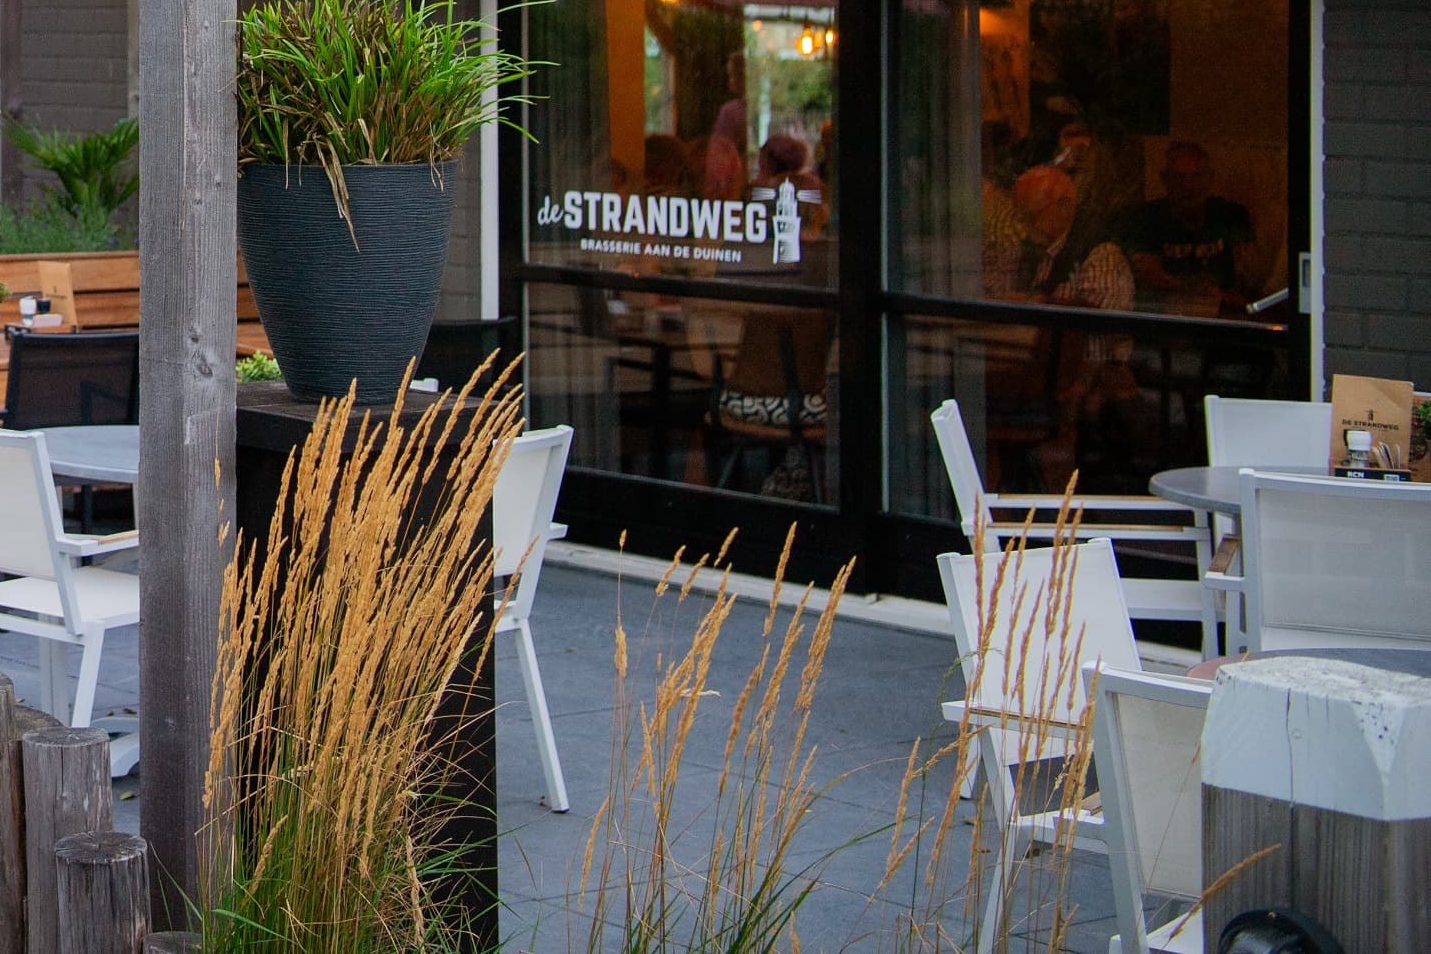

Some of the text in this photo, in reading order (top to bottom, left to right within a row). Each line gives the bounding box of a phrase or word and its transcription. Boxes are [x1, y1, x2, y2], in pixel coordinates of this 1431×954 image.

[537, 190, 768, 243] de STRANDWEG
[580, 238, 743, 263] BRASSERIE AAN DE DUINEN
